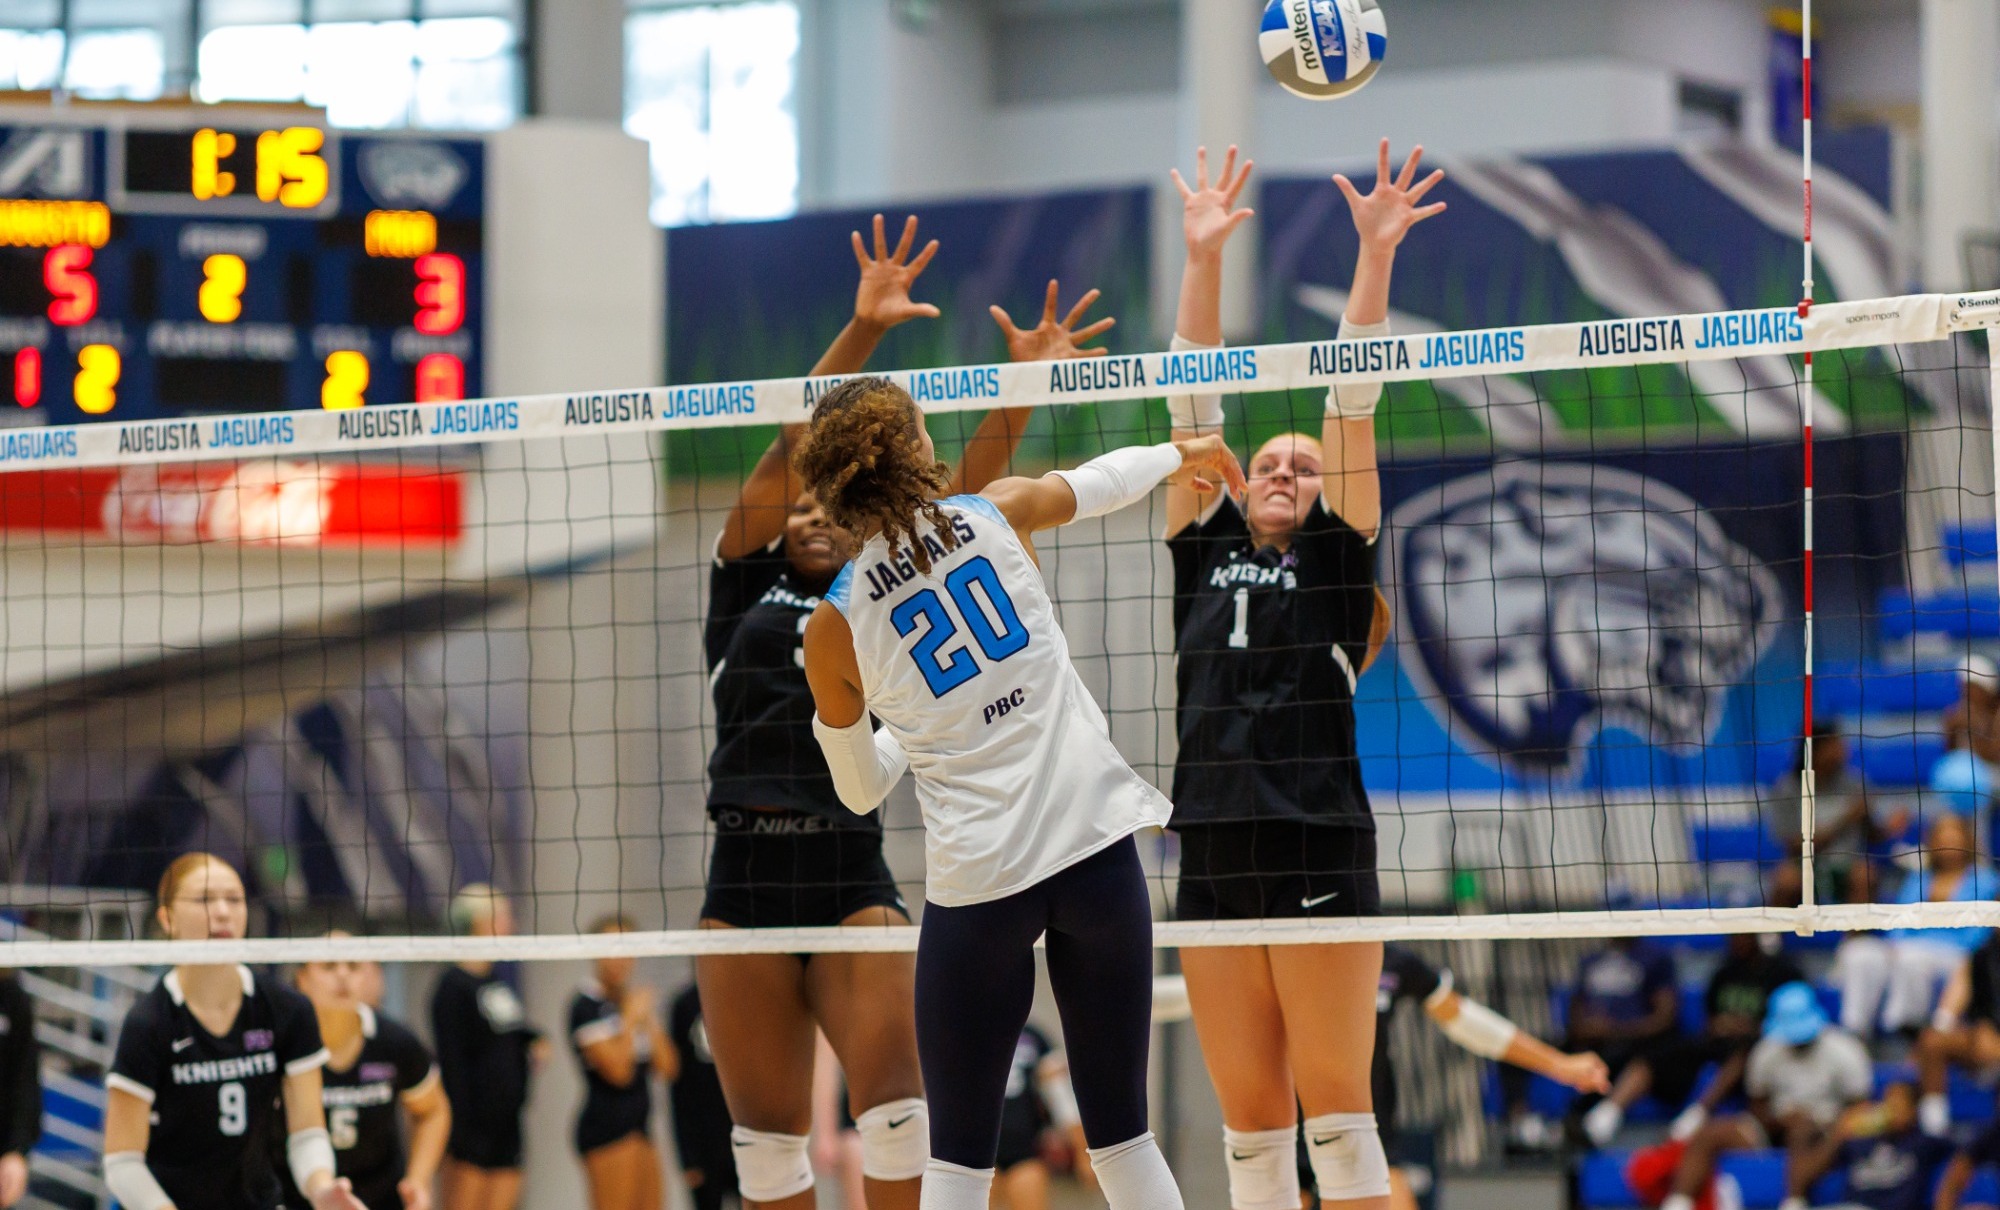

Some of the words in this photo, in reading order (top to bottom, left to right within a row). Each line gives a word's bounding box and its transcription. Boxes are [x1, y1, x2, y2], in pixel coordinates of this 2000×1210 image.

[1294, 0, 1319, 70] molten
[1312, 0, 1344, 57] NCAA
[44, 244, 97, 326] 5
[413, 253, 465, 336] 3
[1309, 340, 1410, 376] AUGUSTA
[1420, 331, 1525, 368] JAGUARS
[1579, 319, 1684, 356] AUGUSTA
[1695, 311, 1804, 348] JAGUARS
[1050, 358, 1146, 393] AUGUSTA
[1156, 350, 1257, 385] JAGUARS
[338, 408, 423, 440] AUGUSTA
[430, 402, 518, 435] JAGUARS
[564, 393, 653, 425] AUGUSTA
[663, 385, 755, 419] JAGUARS
[119, 423, 200, 453] AUGUSTA
[209, 417, 293, 448] JAGUARS
[890, 555, 1031, 699] 20
[1228, 587, 1248, 648] 1
[983, 687, 1025, 725] PBC
[753, 815, 821, 835] NIKE
[172, 1053, 276, 1084] KNIGHTS
[219, 1082, 246, 1136] 9
